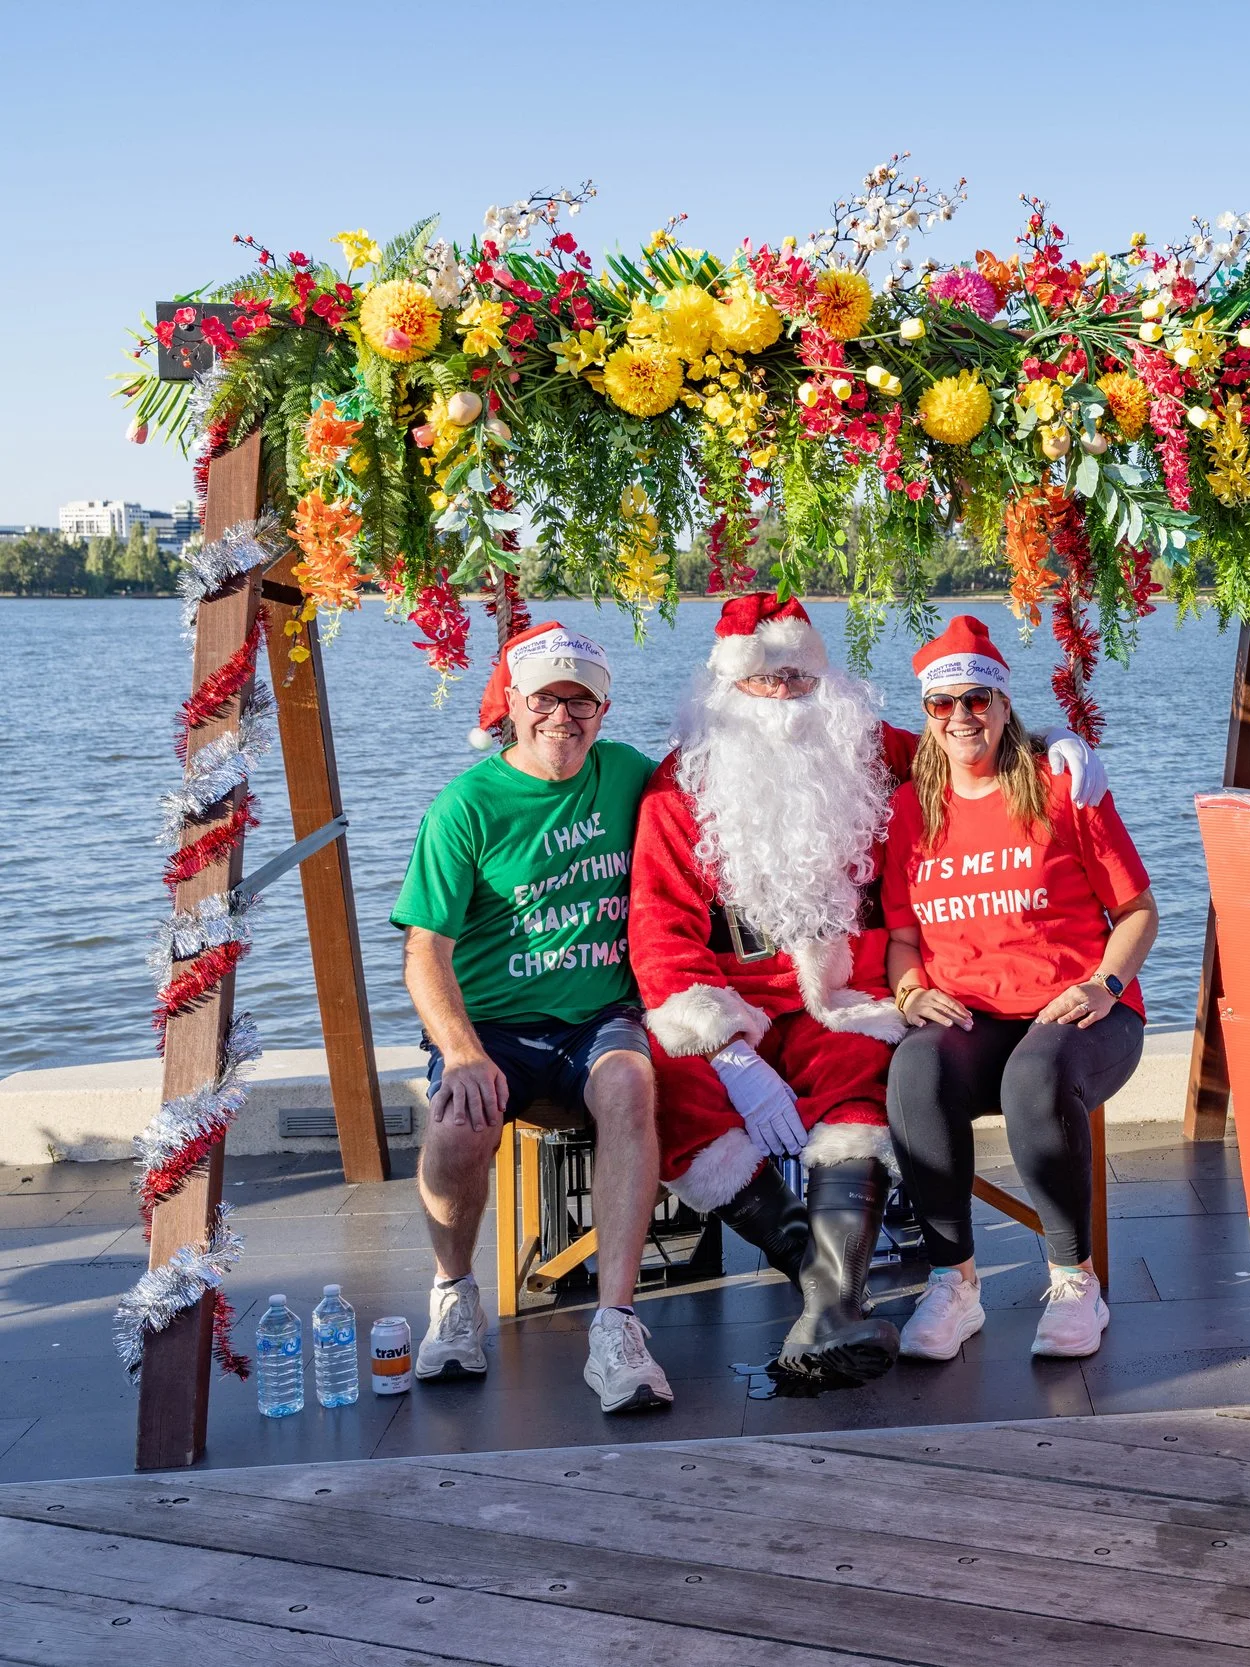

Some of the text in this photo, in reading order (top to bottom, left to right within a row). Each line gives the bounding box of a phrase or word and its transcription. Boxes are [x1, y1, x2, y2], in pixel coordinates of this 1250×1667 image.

[549, 634, 602, 657] Santa Run
[965, 660, 1005, 683] Santa Run
[543, 812, 606, 856] I HAVE
[917, 846, 1032, 883] IT'S ME I'M
[509, 915, 519, 937] I
[523, 901, 591, 934] WANT
[913, 887, 1049, 925] EVERYTHING
